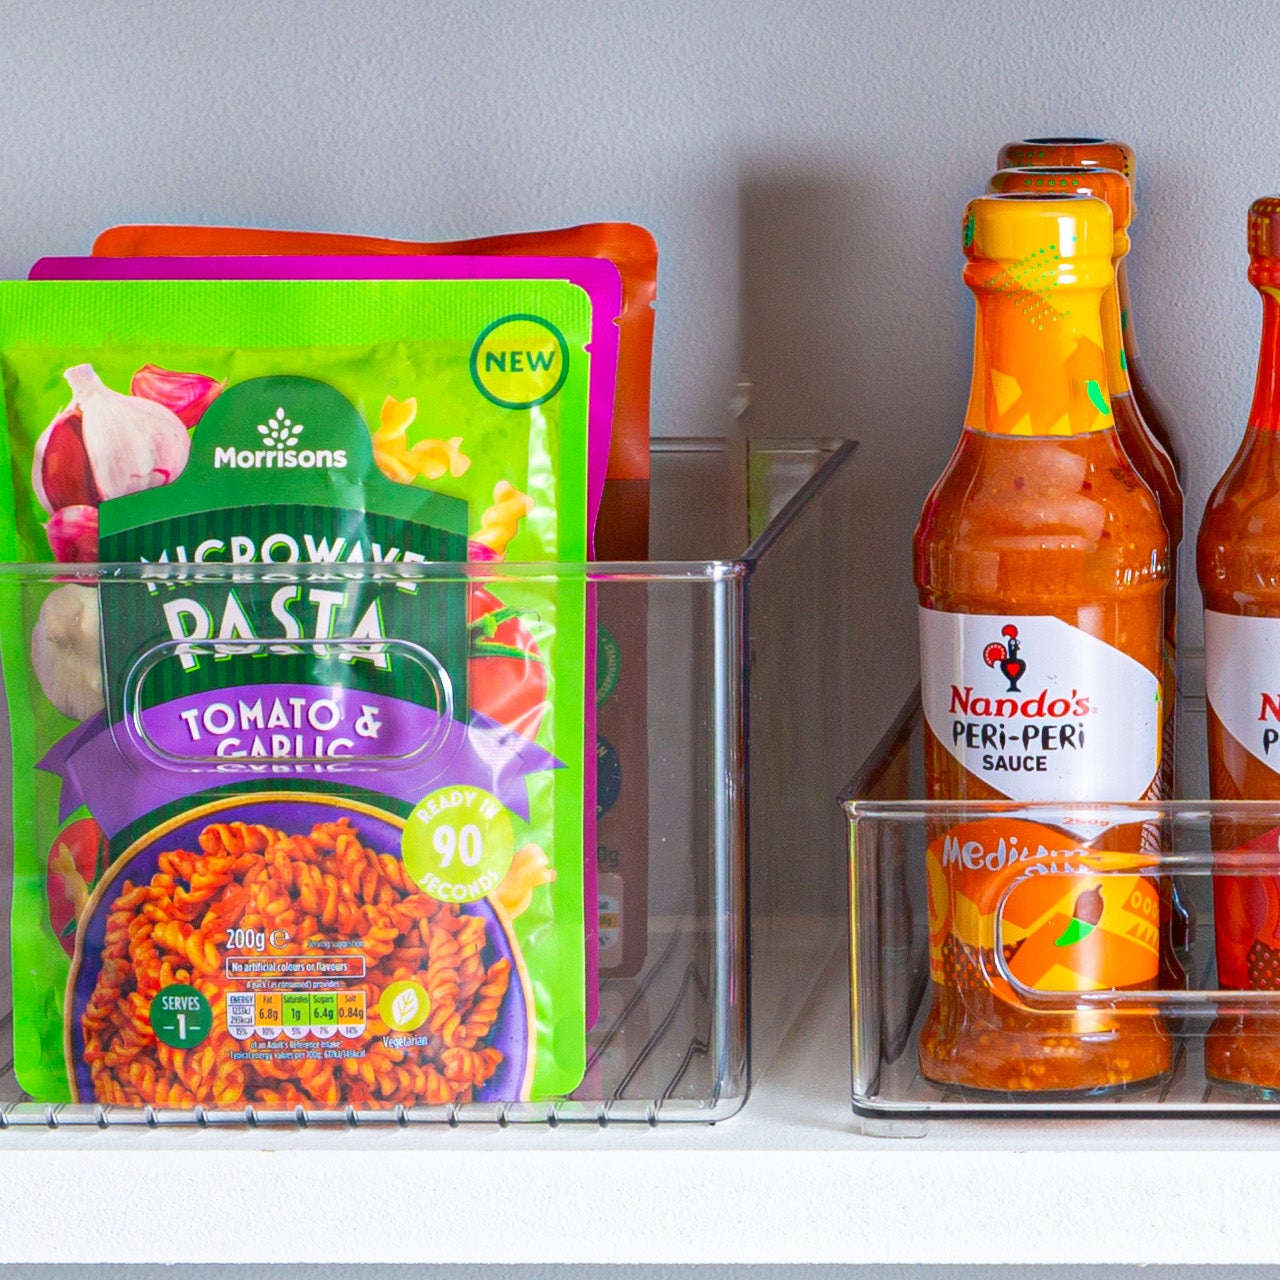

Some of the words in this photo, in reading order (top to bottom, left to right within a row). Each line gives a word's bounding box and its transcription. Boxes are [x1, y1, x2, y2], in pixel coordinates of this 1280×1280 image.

[486, 350, 555, 373] NEW
[214, 446, 347, 469] Morrisons
[949, 686, 1090, 718] Nando's
[181, 697, 342, 741] TOMATO
[982, 755, 1047, 772] SAUCE
[416, 791, 475, 821] READY
[478, 796, 500, 819] IN
[433, 824, 483, 866] 90
[419, 869, 499, 901] SECONDS
[226, 929, 265, 951] 200g
[244, 962, 275, 972] artificial
[278, 962, 304, 972] colours
[316, 962, 348, 971] flavours
[162, 996, 200, 1011] SERVES
[314, 1008, 333, 1020] 6.4g
[339, 1009, 363, 1020] 0.84g
[383, 1035, 428, 1048] Vegetarian
